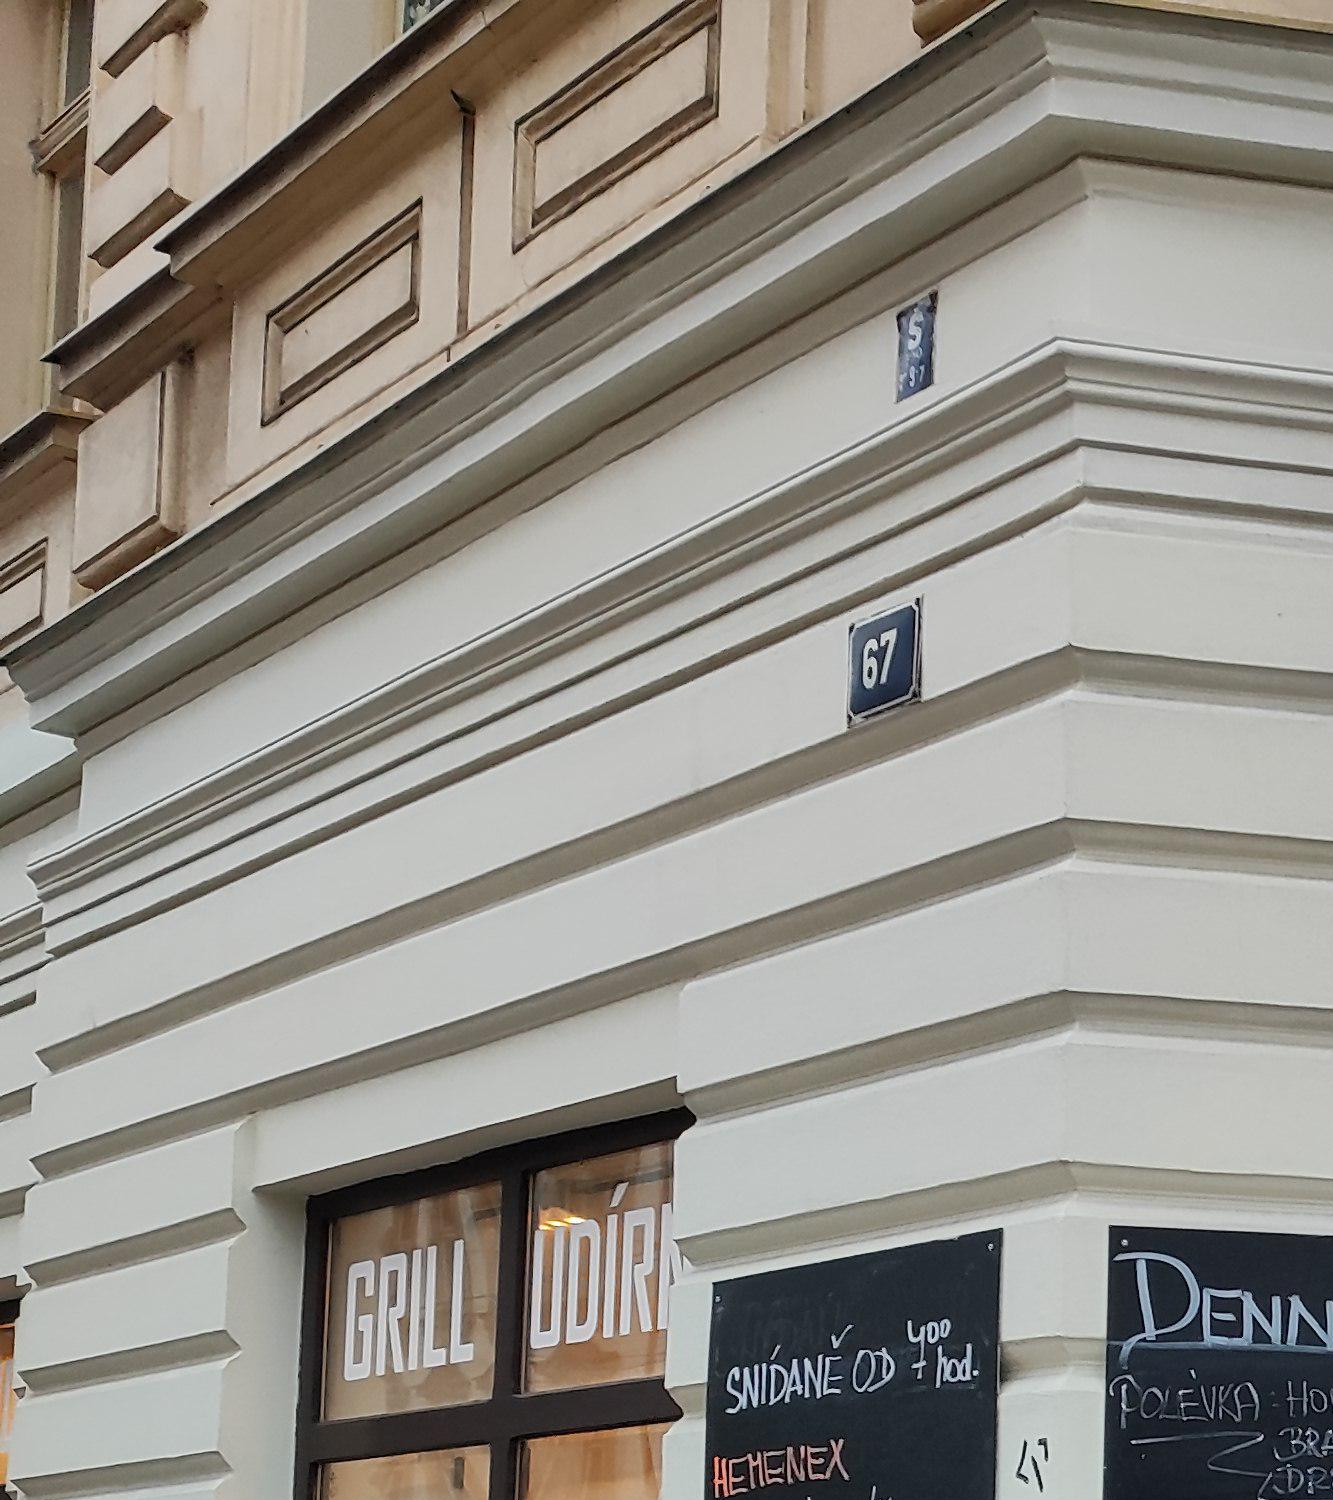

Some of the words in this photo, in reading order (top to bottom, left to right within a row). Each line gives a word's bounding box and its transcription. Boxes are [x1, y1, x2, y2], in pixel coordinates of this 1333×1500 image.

[861, 627, 898, 690] 67
[343, 1239, 474, 1381] GRILL
[725, 1324, 854, 1414] SNÍDANĚ
[853, 1347, 896, 1393] OD
[714, 1439, 850, 1498] HEMENEX
